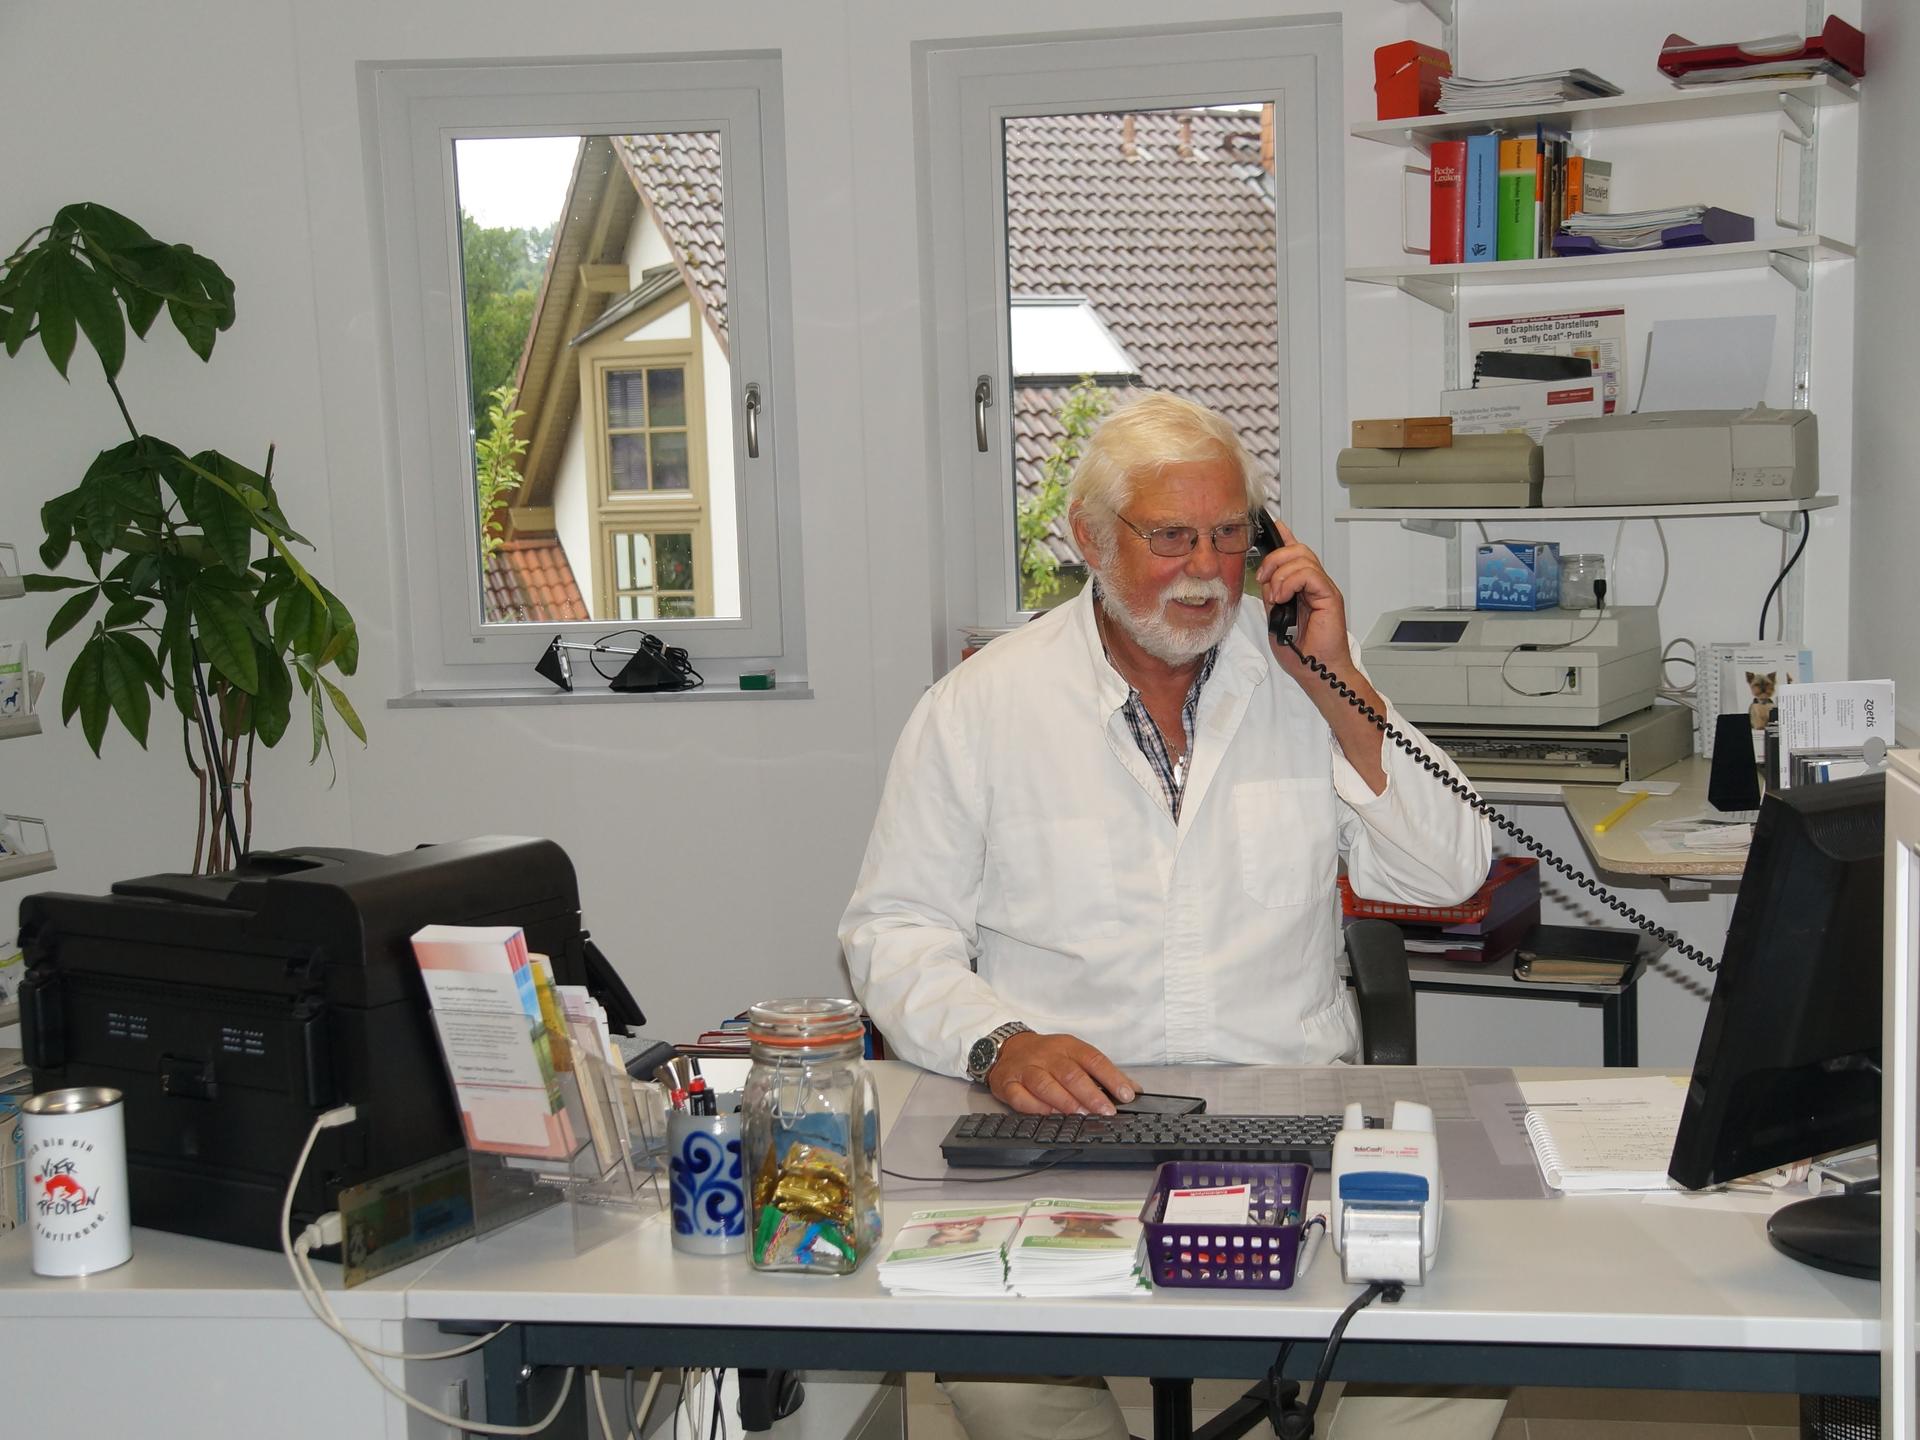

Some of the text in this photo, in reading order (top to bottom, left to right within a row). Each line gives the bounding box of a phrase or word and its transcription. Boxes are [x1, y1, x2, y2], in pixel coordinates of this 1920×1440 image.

[1434, 167, 1455, 175] Roche
[1496, 326, 1509, 335] Die
[1511, 322, 1553, 334] Graphische
[1555, 319, 1599, 330] Darstellung
[1504, 336, 1518, 345] des
[1864, 699, 1877, 728] zoetis
[37, 1187, 100, 1215] PFOTEN
